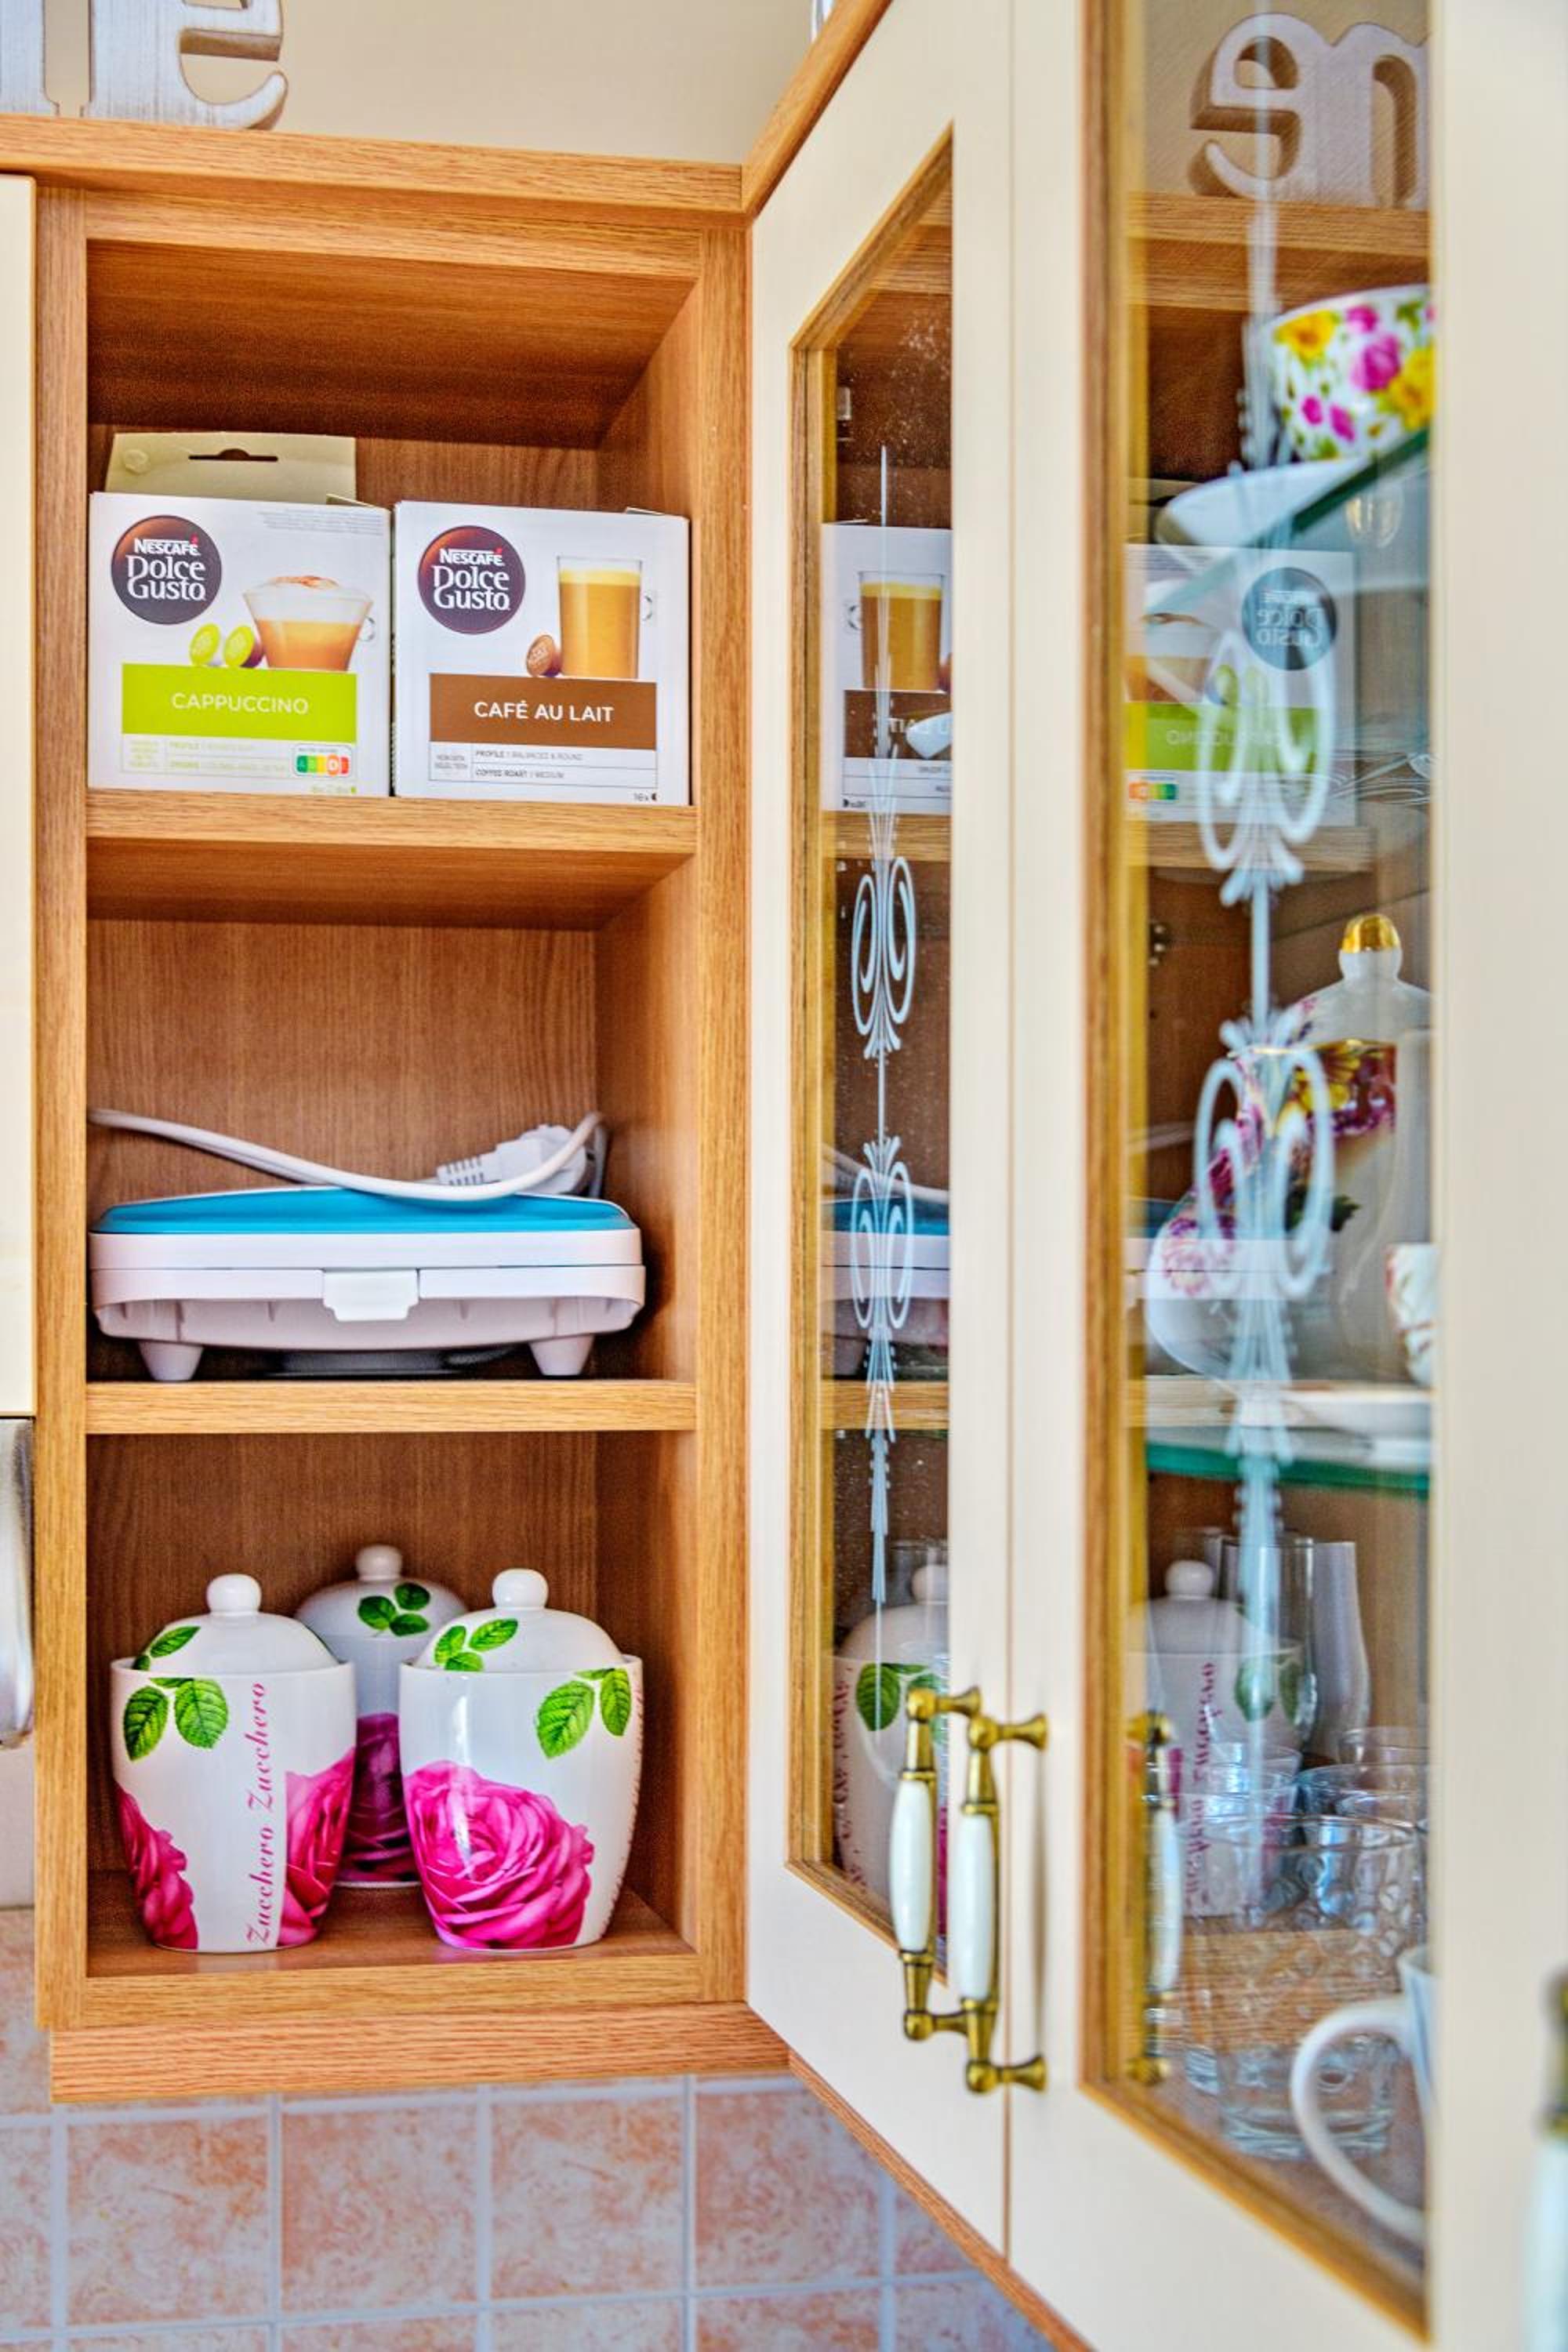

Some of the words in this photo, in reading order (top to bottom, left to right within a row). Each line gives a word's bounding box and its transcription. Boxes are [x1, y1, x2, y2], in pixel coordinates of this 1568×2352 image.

[125, 554, 205, 581] Dolce
[431, 565, 510, 590] Dolce
[127, 579, 206, 601] Gusto
[434, 587, 511, 611] Gusto
[172, 692, 309, 715] CAPPUCCINO
[474, 700, 528, 719] CAFÉ
[535, 704, 563, 720] AU
[569, 705, 615, 722] LAIT
[245, 1682, 274, 1811] Zucchero
[246, 1827, 274, 1944] Zucchero
